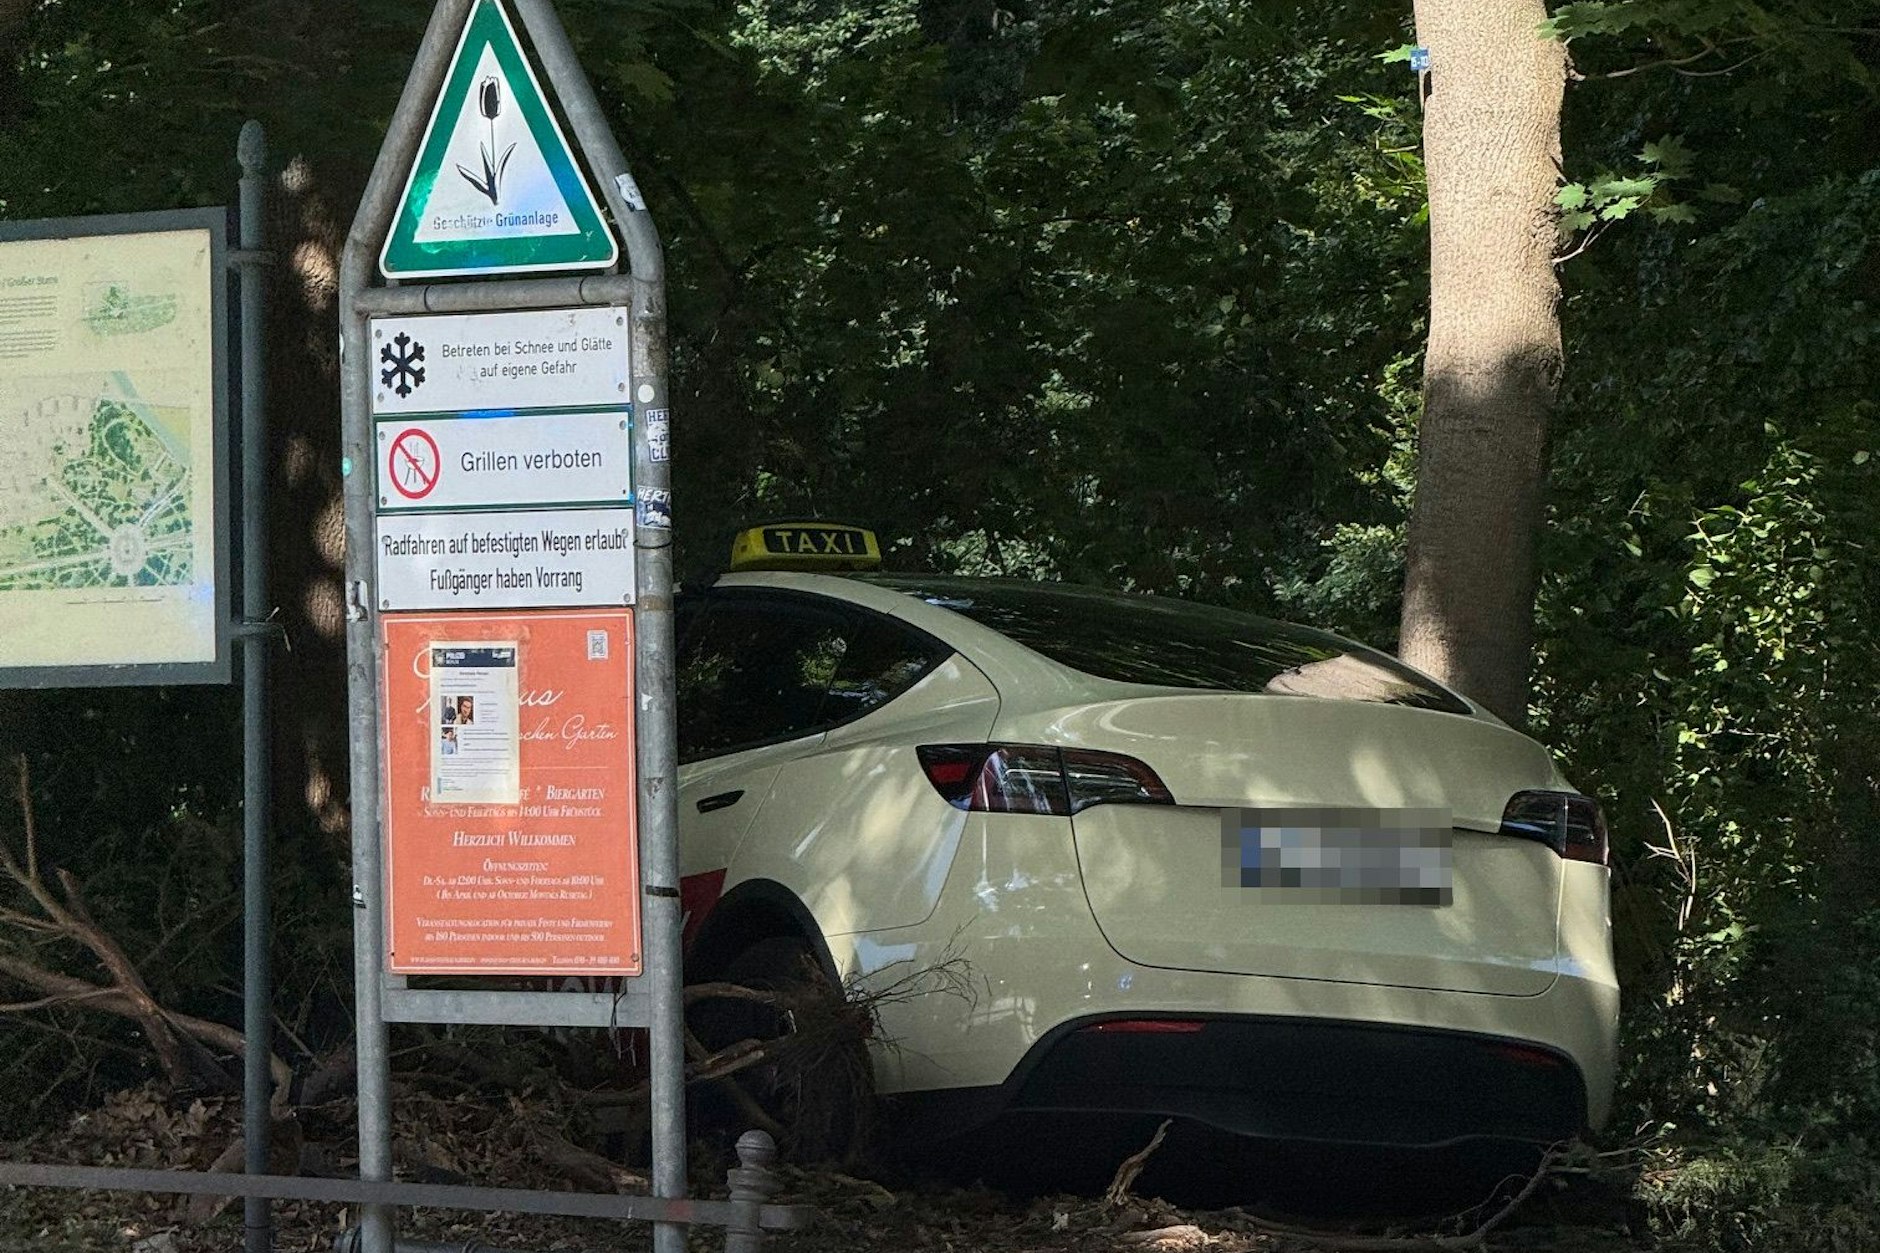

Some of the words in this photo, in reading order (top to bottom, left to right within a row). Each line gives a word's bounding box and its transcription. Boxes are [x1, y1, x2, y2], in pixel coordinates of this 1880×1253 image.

[495, 211, 559, 228] Grünanlage
[442, 344, 490, 358] Betreten
[494, 341, 511, 355] bei
[514, 340, 554, 355] Schnee
[558, 338, 577, 352] und
[581, 337, 613, 351] Glätte
[480, 363, 498, 377] auf
[502, 362, 537, 379] eigene
[541, 360, 577, 375] Gefahr
[461, 451, 518, 472] Grillen
[523, 449, 602, 470] verboten
[383, 534, 445, 556] Radfahren
[449, 532, 468, 554] auf
[472, 531, 538, 558] befestigten
[541, 530, 581, 557] Wegen
[775, 531, 854, 554] TAXI
[430, 568, 493, 596] Fußgänger
[496, 567, 533, 589] haben
[536, 566, 583, 593] Vorrang
[562, 714, 618, 749] Garten
